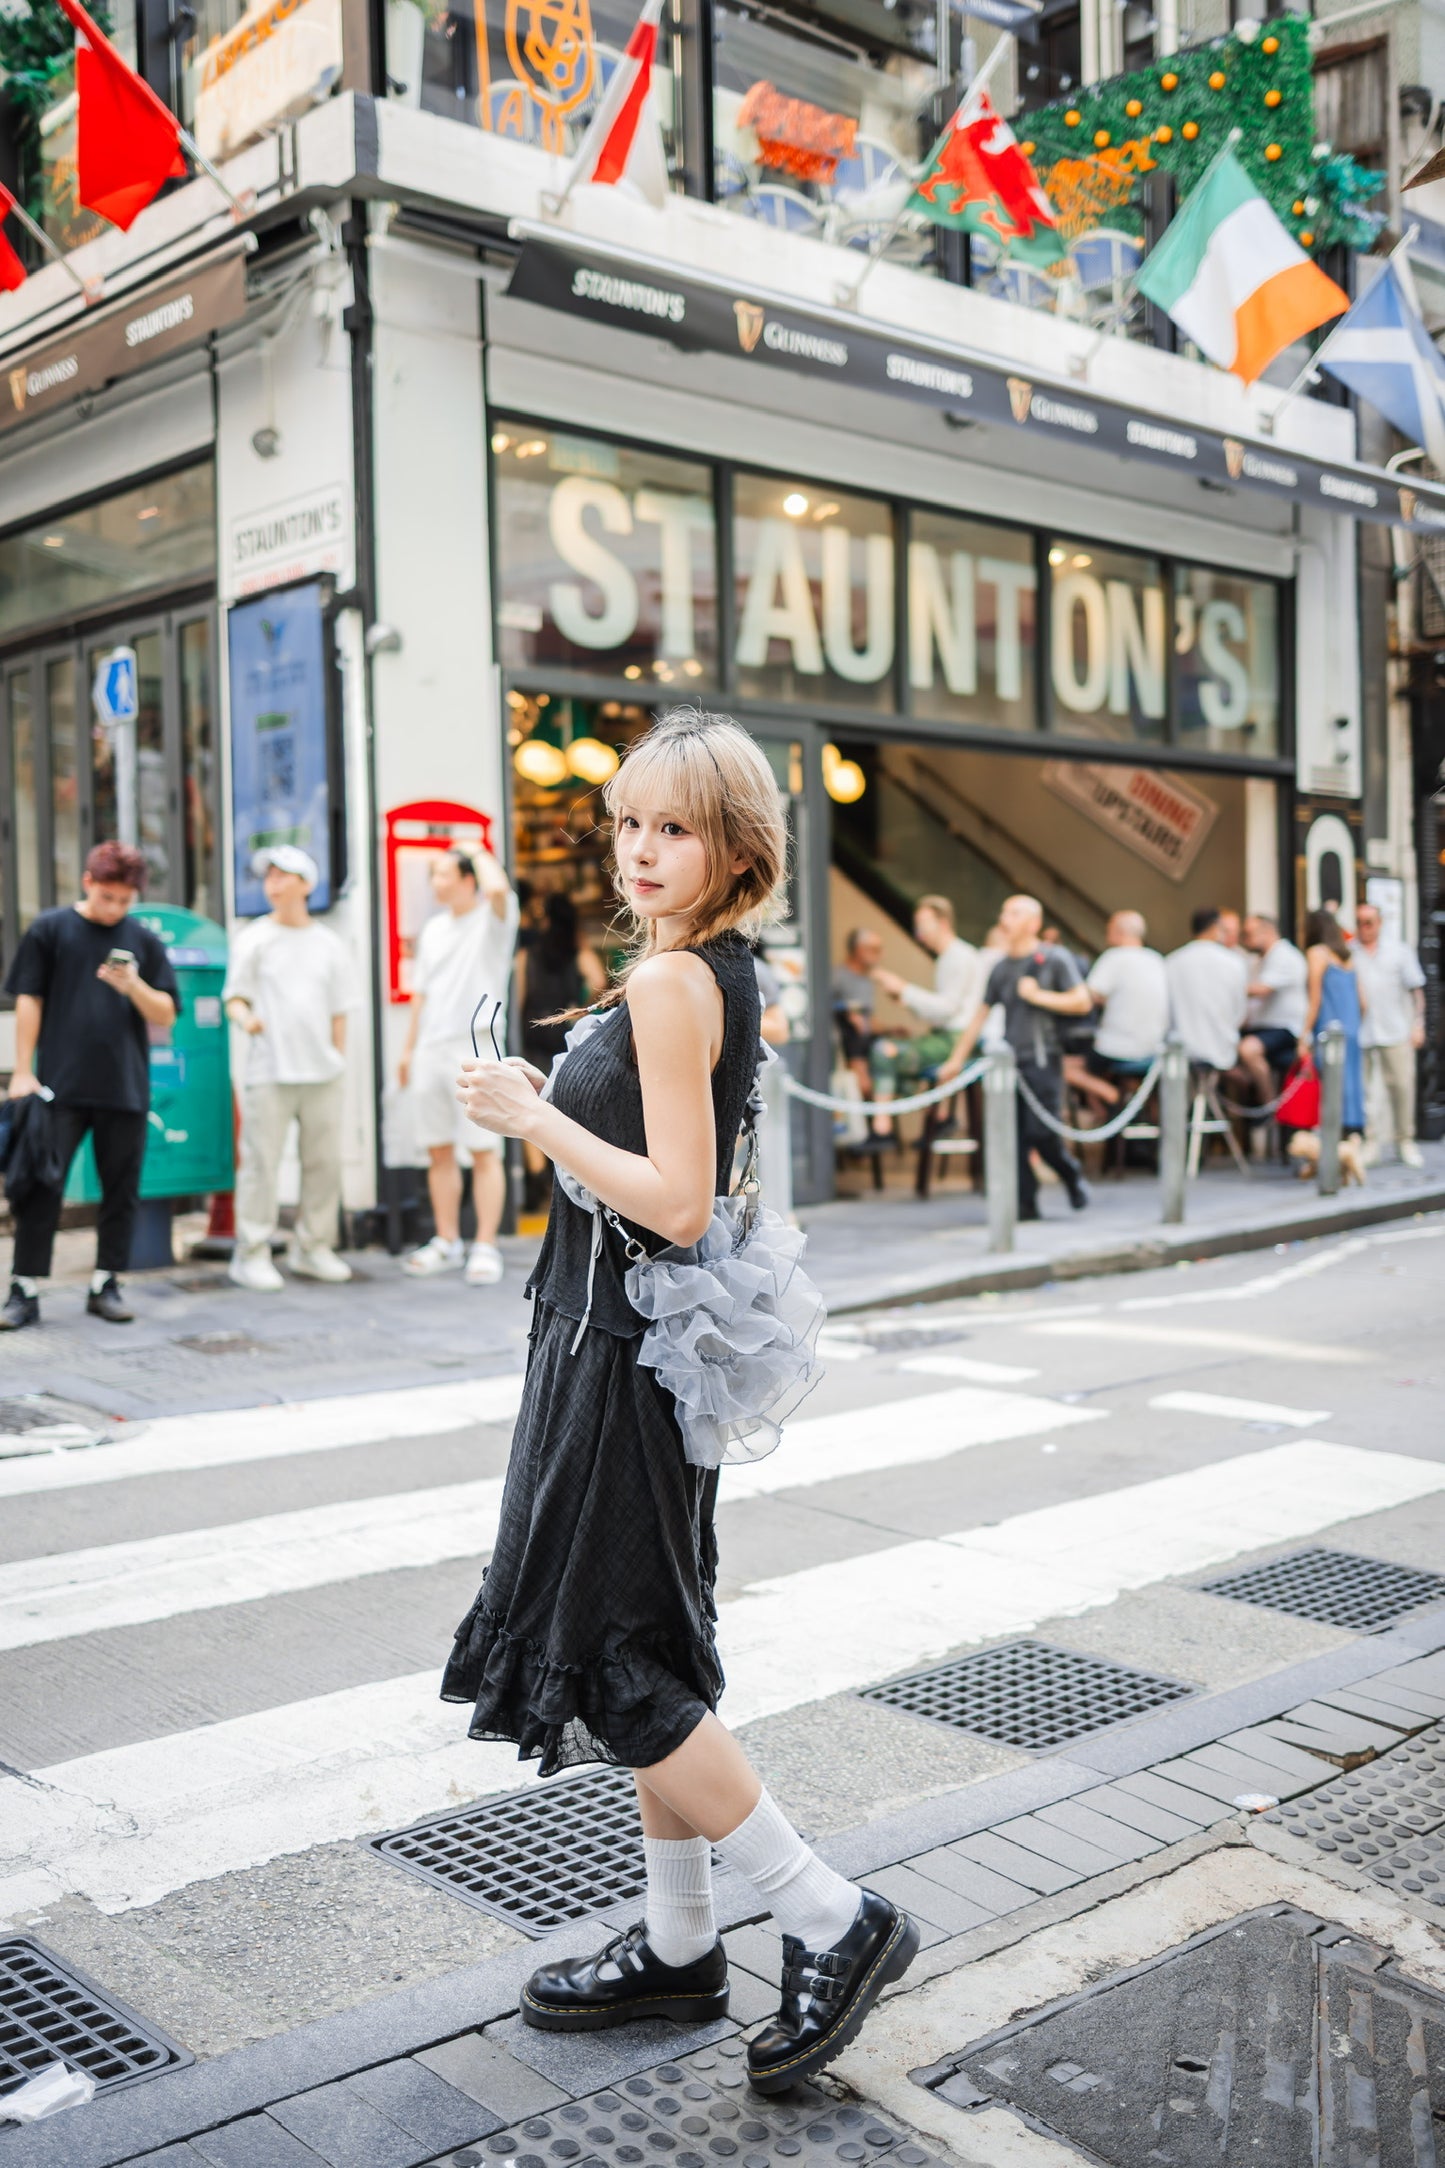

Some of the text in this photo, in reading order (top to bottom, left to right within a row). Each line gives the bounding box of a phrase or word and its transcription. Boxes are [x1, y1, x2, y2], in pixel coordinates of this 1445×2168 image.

[126, 295, 193, 347] STAUNTON'S
[572, 269, 685, 322] STAUNTON'S
[887, 355, 973, 398] STAUNTON'S
[235, 499, 341, 562] STAUNTON'S
[549, 475, 1248, 731] STAUNTON'S
